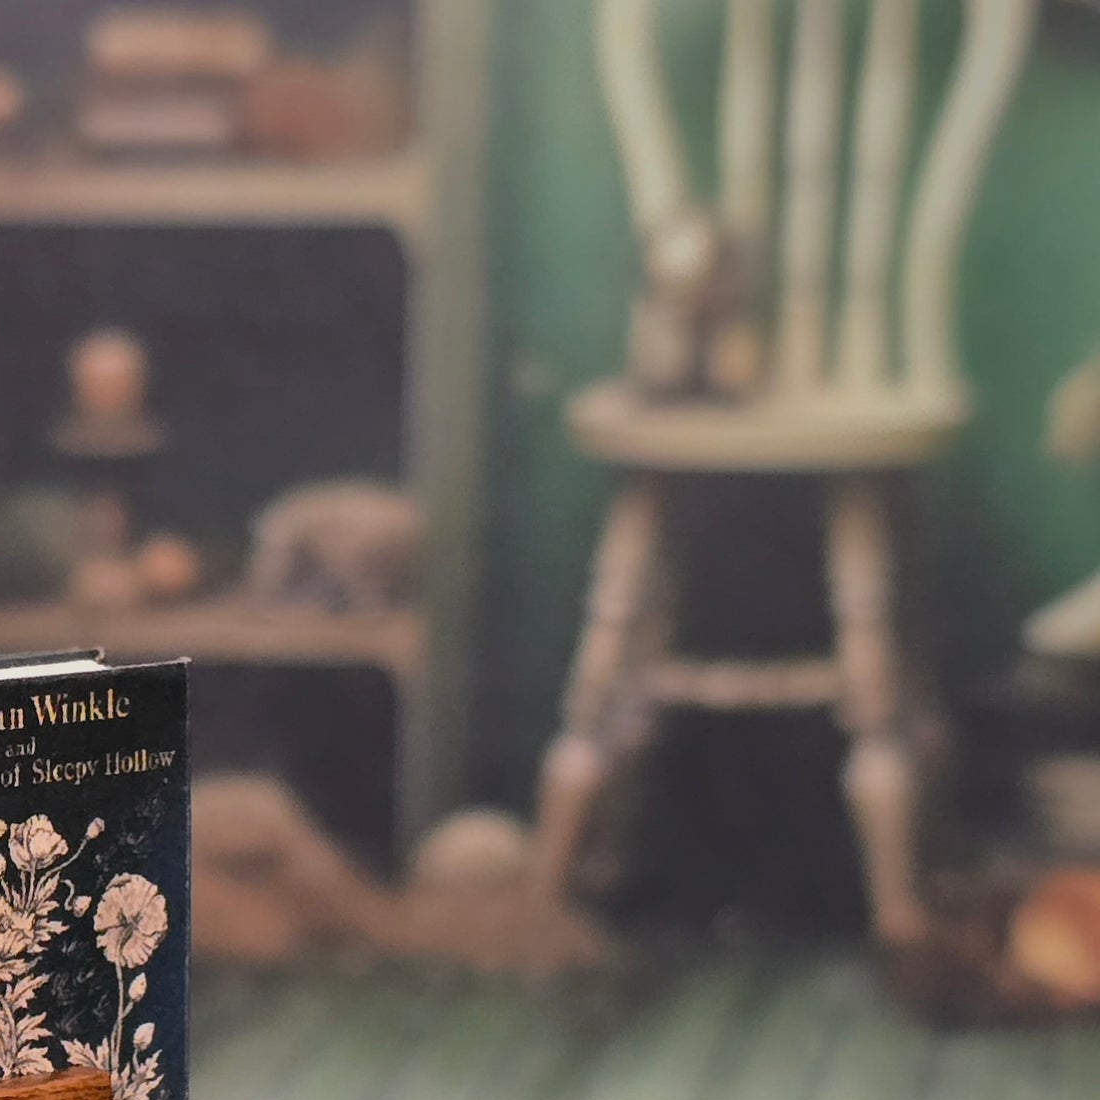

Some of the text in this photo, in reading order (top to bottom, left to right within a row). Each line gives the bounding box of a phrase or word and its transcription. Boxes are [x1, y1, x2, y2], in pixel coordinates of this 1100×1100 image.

[30, 687, 131, 726] Winkle
[4, 735, 37, 758] and
[0, 762, 21, 788] of
[32, 758, 99, 787] Sleepy
[104, 748, 176, 777] Hollow
